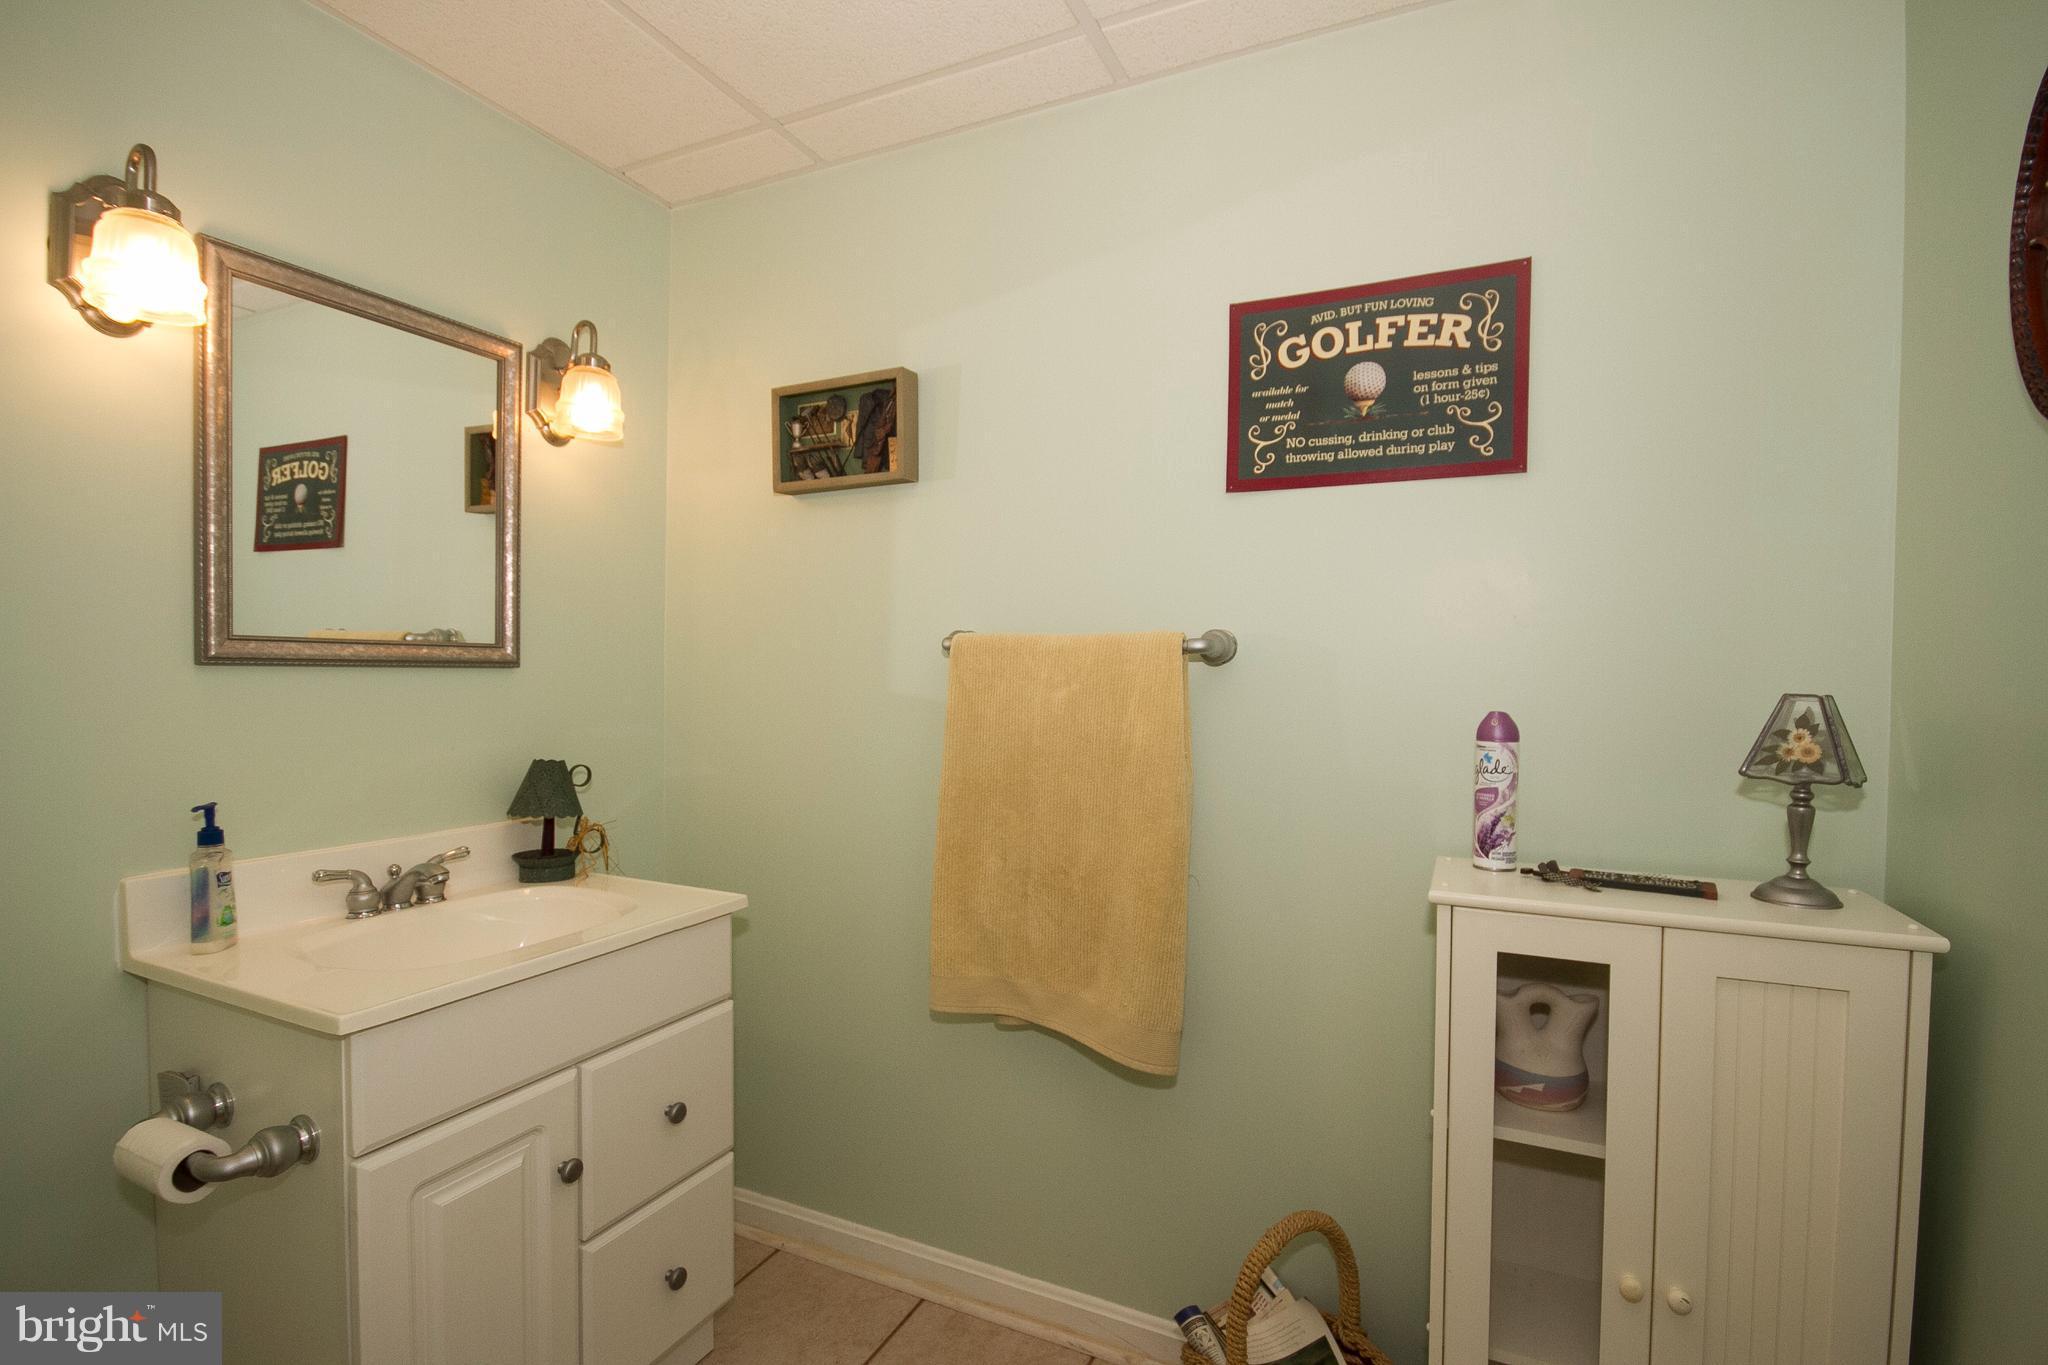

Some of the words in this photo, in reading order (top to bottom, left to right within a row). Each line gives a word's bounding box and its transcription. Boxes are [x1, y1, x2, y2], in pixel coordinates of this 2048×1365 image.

[1340, 304, 1362, 317] BUT
[1364, 301, 1388, 313] FUN
[1390, 297, 1435, 309] LOVING
[1277, 313, 1472, 369] GOLFER
[1413, 368, 1459, 381] lessons
[1462, 364, 1472, 375] &
[1475, 362, 1499, 374] tips
[1251, 385, 1294, 398] available
[1295, 384, 1310, 394] for
[1413, 384, 1429, 393] on
[1431, 380, 1460, 391] form
[1463, 376, 1498, 389] given
[1265, 398, 1295, 409] match
[1420, 396, 1430, 406] (1
[1259, 414, 1270, 422] or
[1271, 410, 1301, 422] medal
[1286, 437, 1306, 449] NO
[1308, 434, 1356, 446] cussing,
[1358, 429, 1408, 442] drinking
[1411, 429, 1425, 437] or
[1427, 423, 1455, 436] club
[1285, 451, 1335, 463] throwing
[1337, 446, 1383, 460] allowed
[1386, 443, 1425, 456] during
[1428, 440, 1456, 454] play
